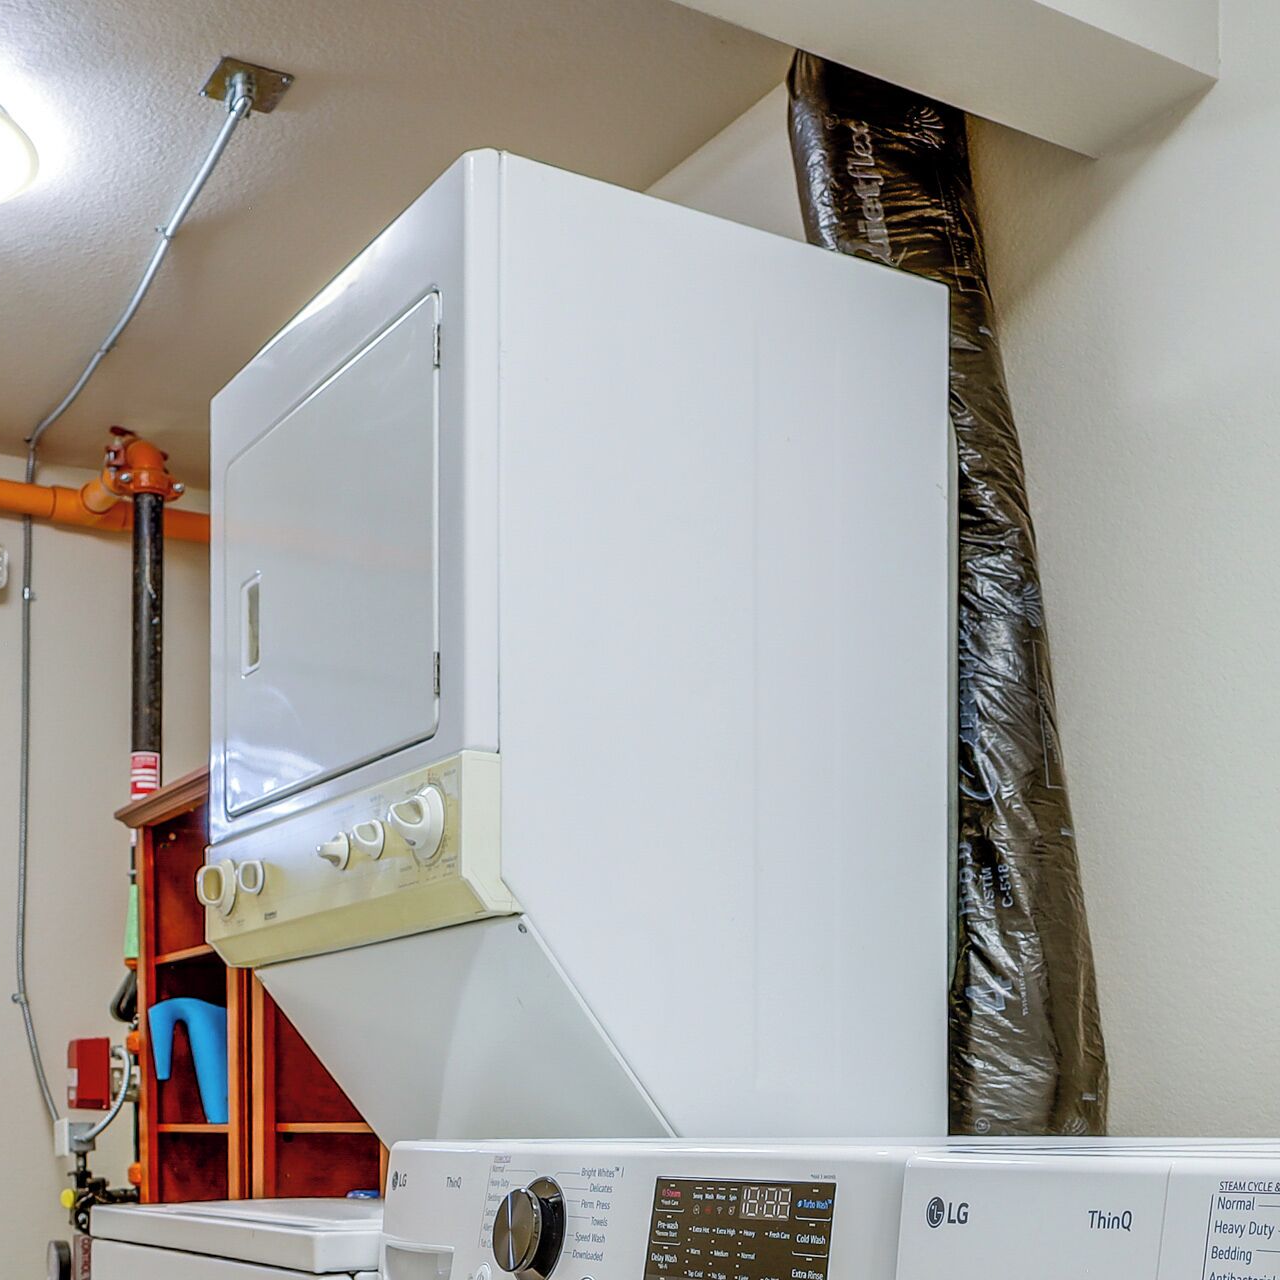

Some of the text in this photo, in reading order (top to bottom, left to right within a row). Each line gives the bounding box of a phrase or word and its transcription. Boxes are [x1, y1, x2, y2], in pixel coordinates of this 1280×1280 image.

[982, 867, 995, 909] ASTM
[998, 863, 1014, 908] C-518
[965, 976, 1013, 1011] 4
[581, 1167, 596, 1180] Bright
[399, 1173, 407, 1187] LG
[446, 1176, 462, 1189] ThinQ
[1219, 1180, 1246, 1191] STEAM
[1248, 1181, 1273, 1192] CYCLE
[1274, 1182, 1280, 1192] &
[589, 1183, 613, 1193] Delicates
[665, 1189, 681, 1198] Steam
[729, 1194, 738, 1202] Spin
[1217, 1196, 1256, 1211] Normal
[596, 1200, 610, 1210] Press
[803, 1200, 815, 1209] Turbo
[947, 1202, 970, 1225] LG
[591, 1216, 608, 1227] Towels
[1087, 1210, 1133, 1232] ThinQ
[716, 1227, 736, 1237] Extra High
[743, 1230, 756, 1238] Heavy
[780, 1231, 790, 1240] Care
[1214, 1219, 1275, 1240] Heavy Duty
[575, 1231, 606, 1243] Speed Wash
[796, 1234, 826, 1245] Cold Wash
[572, 1249, 604, 1261] Downloaded
[651, 1252, 677, 1263] Delay Wash
[740, 1252, 756, 1260] Normal
[1210, 1245, 1253, 1266] Bedding
[694, 1270, 703, 1278] Cold
[717, 1272, 726, 1280] Spin
[791, 1268, 824, 1280] Extra Rinse
